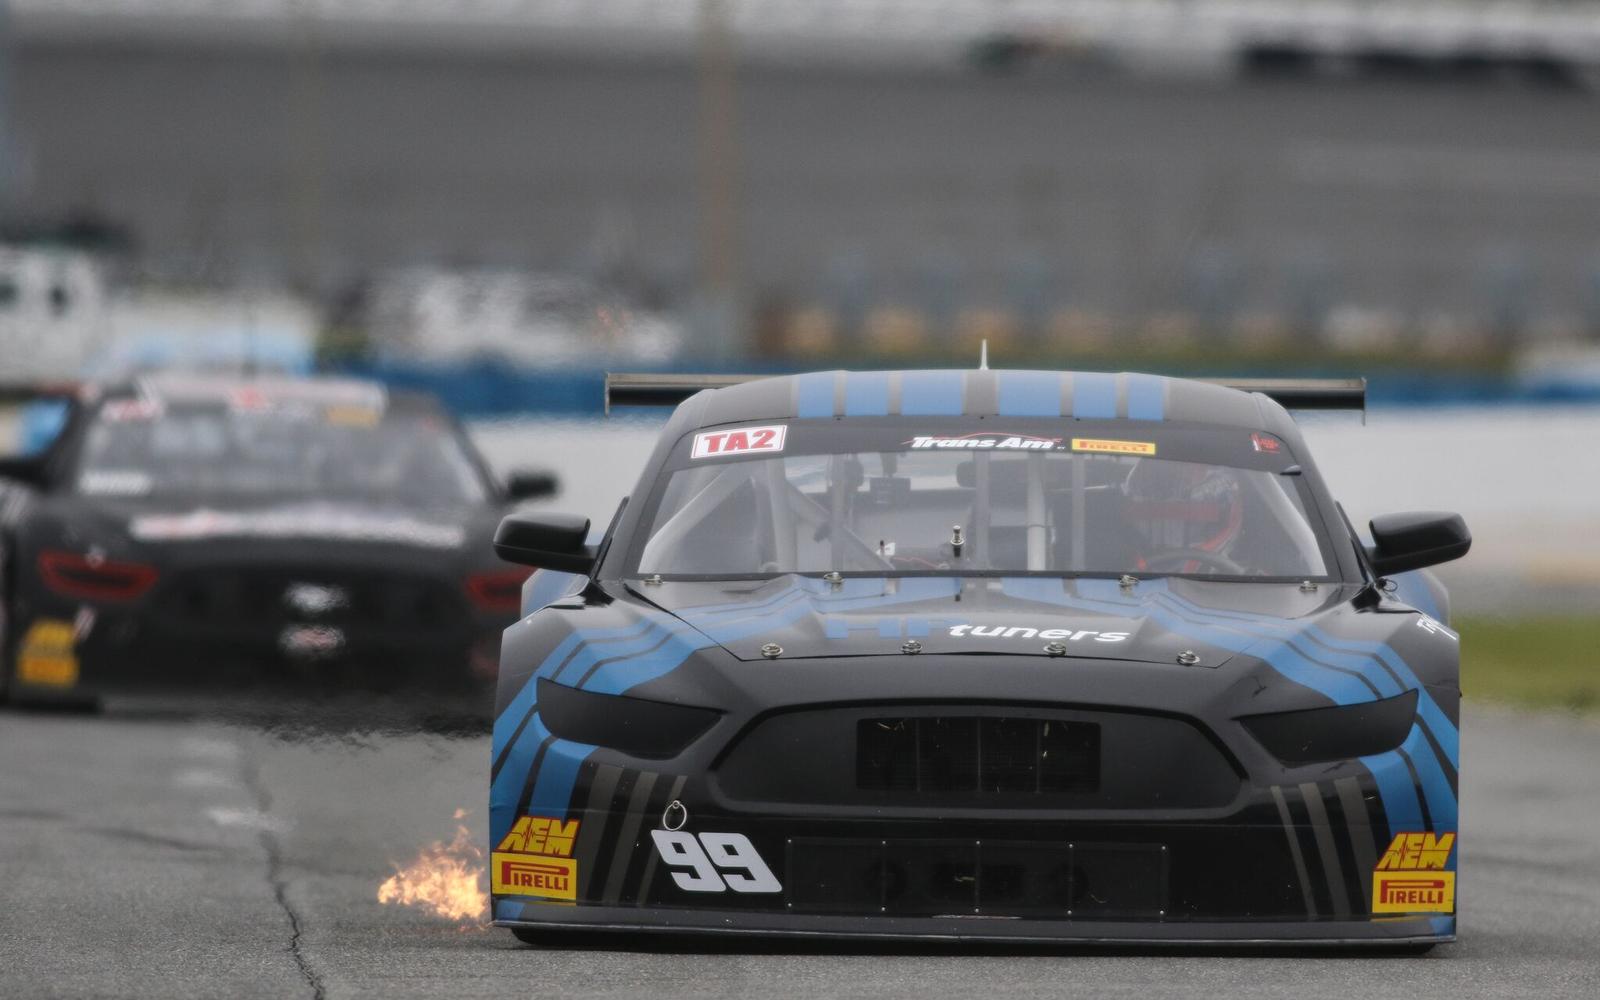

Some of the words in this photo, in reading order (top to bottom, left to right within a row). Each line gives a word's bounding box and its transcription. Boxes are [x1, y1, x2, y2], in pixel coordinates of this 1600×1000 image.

[704, 429, 776, 453] TA2
[911, 436, 997, 449] Trans
[996, 437, 1055, 449] Am
[1079, 440, 1148, 452] PIRELLI
[949, 623, 1131, 643] tuners
[496, 816, 580, 857] AEM
[651, 829, 783, 893] 99
[1376, 832, 1456, 870] AEM
[501, 861, 570, 891] PIRELLI
[1380, 879, 1446, 904] PIRELLI
